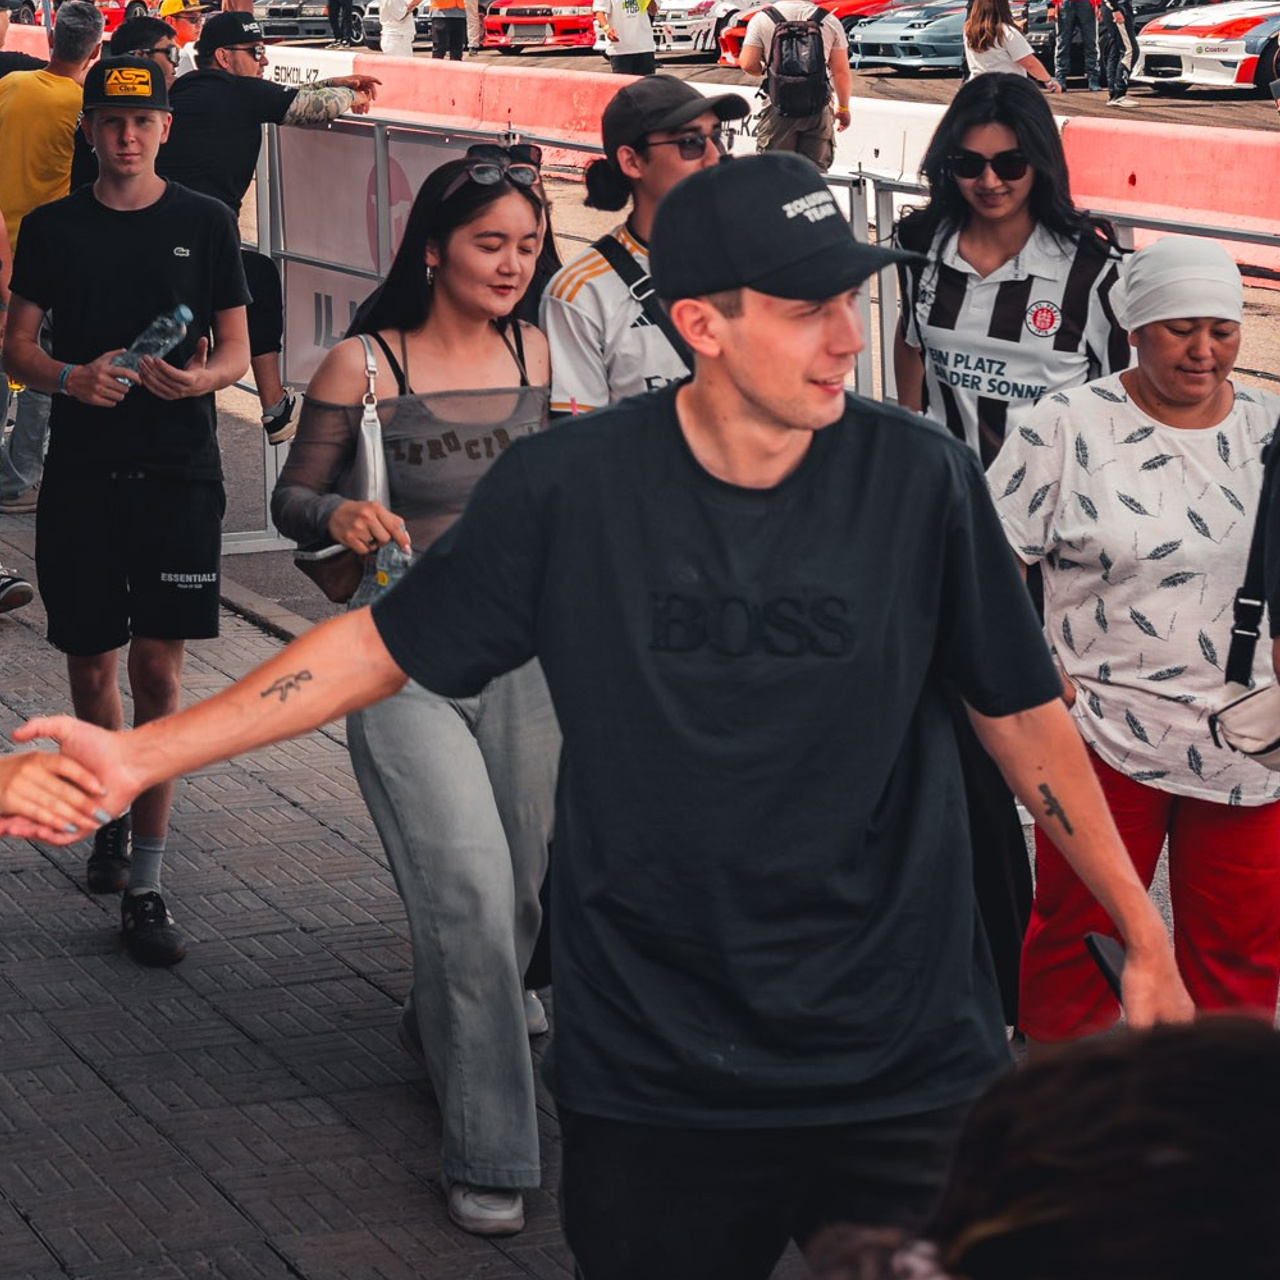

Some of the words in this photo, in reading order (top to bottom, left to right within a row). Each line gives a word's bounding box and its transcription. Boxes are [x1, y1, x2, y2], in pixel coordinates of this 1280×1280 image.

[107, 70, 150, 84] ASP
[954, 353, 1007, 377] PLATZ
[949, 371, 982, 391] DER
[161, 573, 217, 583] ESSENTIALS
[648, 591, 853, 658] BOSS
